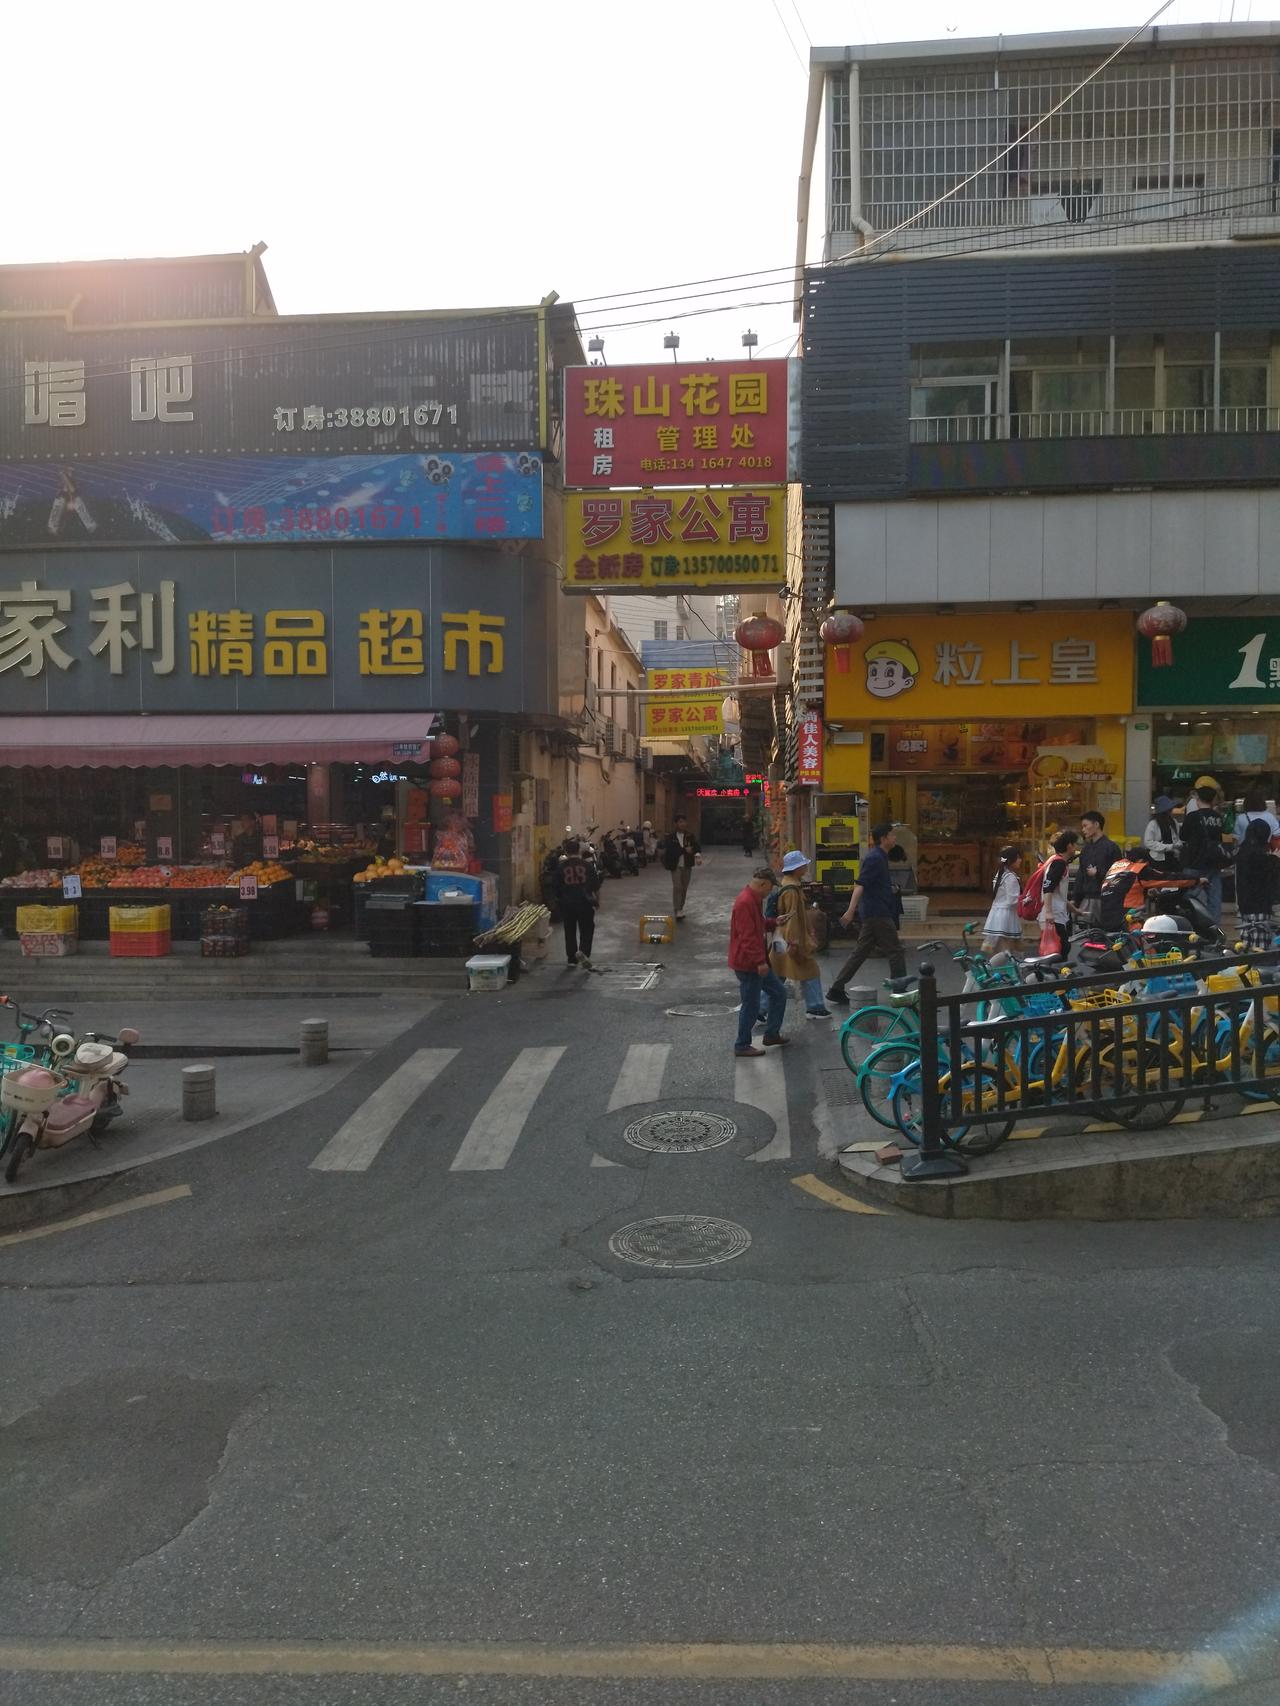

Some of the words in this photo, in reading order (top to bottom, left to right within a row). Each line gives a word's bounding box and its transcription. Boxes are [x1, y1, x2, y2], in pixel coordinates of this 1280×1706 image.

[24, 355, 194, 427] 唱吧
[583, 372, 769, 419] 珠山花园
[273, 403, 459, 432] 订房:38801671
[656, 423, 755, 452] 管理处
[592, 427, 615, 476] 租房
[701, 456, 733, 470] 1647
[739, 455, 773, 468] 4018
[581, 492, 771, 547] 罗家公寓
[574, 554, 644, 580] 全新房
[0, 580, 177, 678] 家利
[188, 608, 507, 677] 精品超市
[933, 638, 1100, 687] 粒上皇
[651, 705, 718, 725] 罗家公寓
